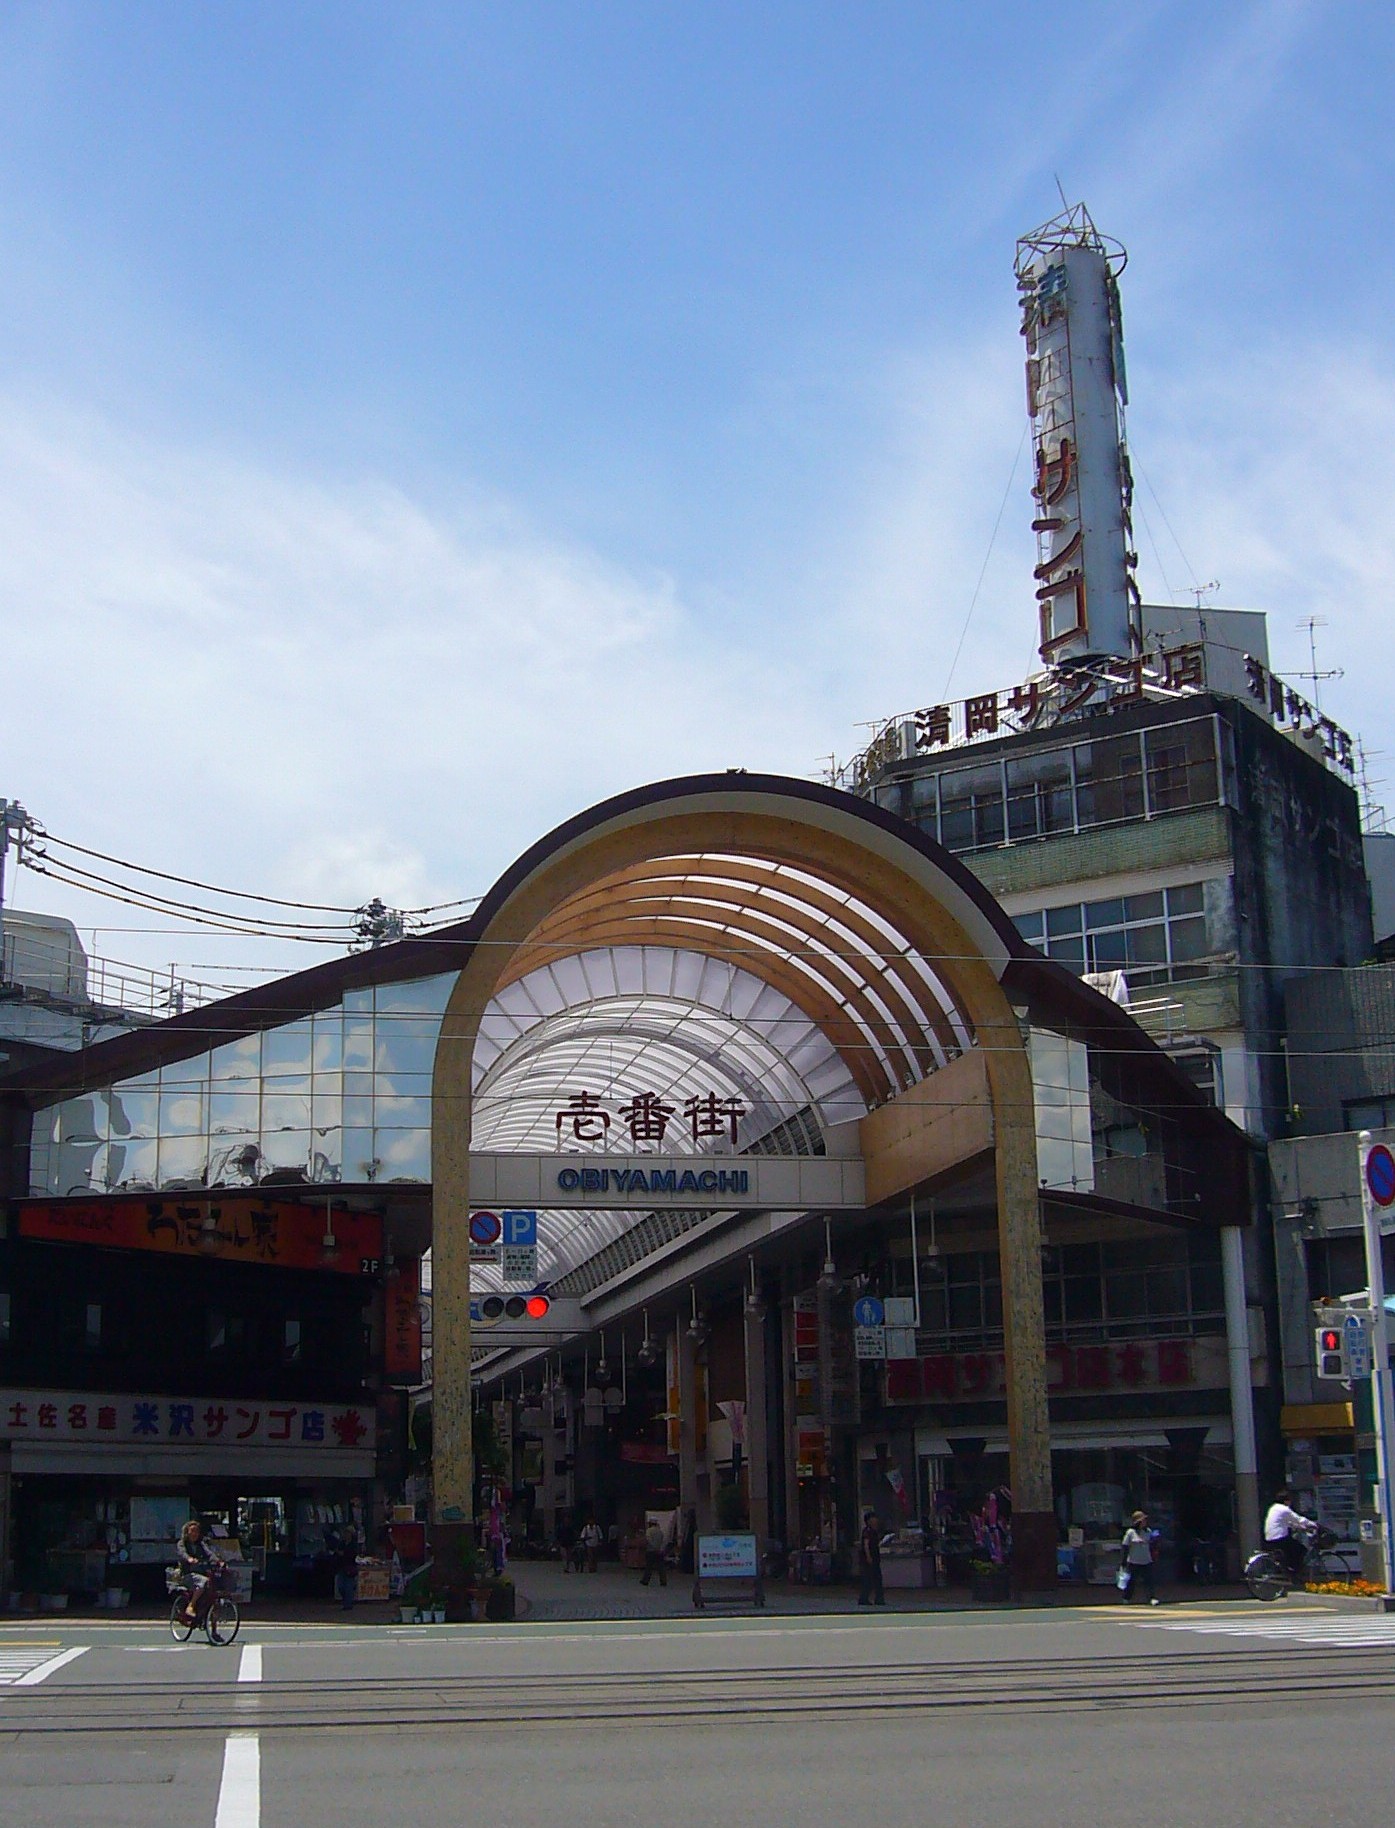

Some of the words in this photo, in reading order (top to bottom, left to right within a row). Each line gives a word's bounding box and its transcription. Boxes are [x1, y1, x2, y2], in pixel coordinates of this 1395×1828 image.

[914, 645, 1202, 747] 清岡サンゴ店
[555, 1090, 747, 1145] 壱番街
[557, 1167, 749, 1193] OBIYAMACHI
[512, 1215, 531, 1242] P
[361, 1258, 379, 1274] 2F
[7, 1401, 118, 1430] 土佐名産
[132, 1402, 325, 1442] 米沢サンゴ店
